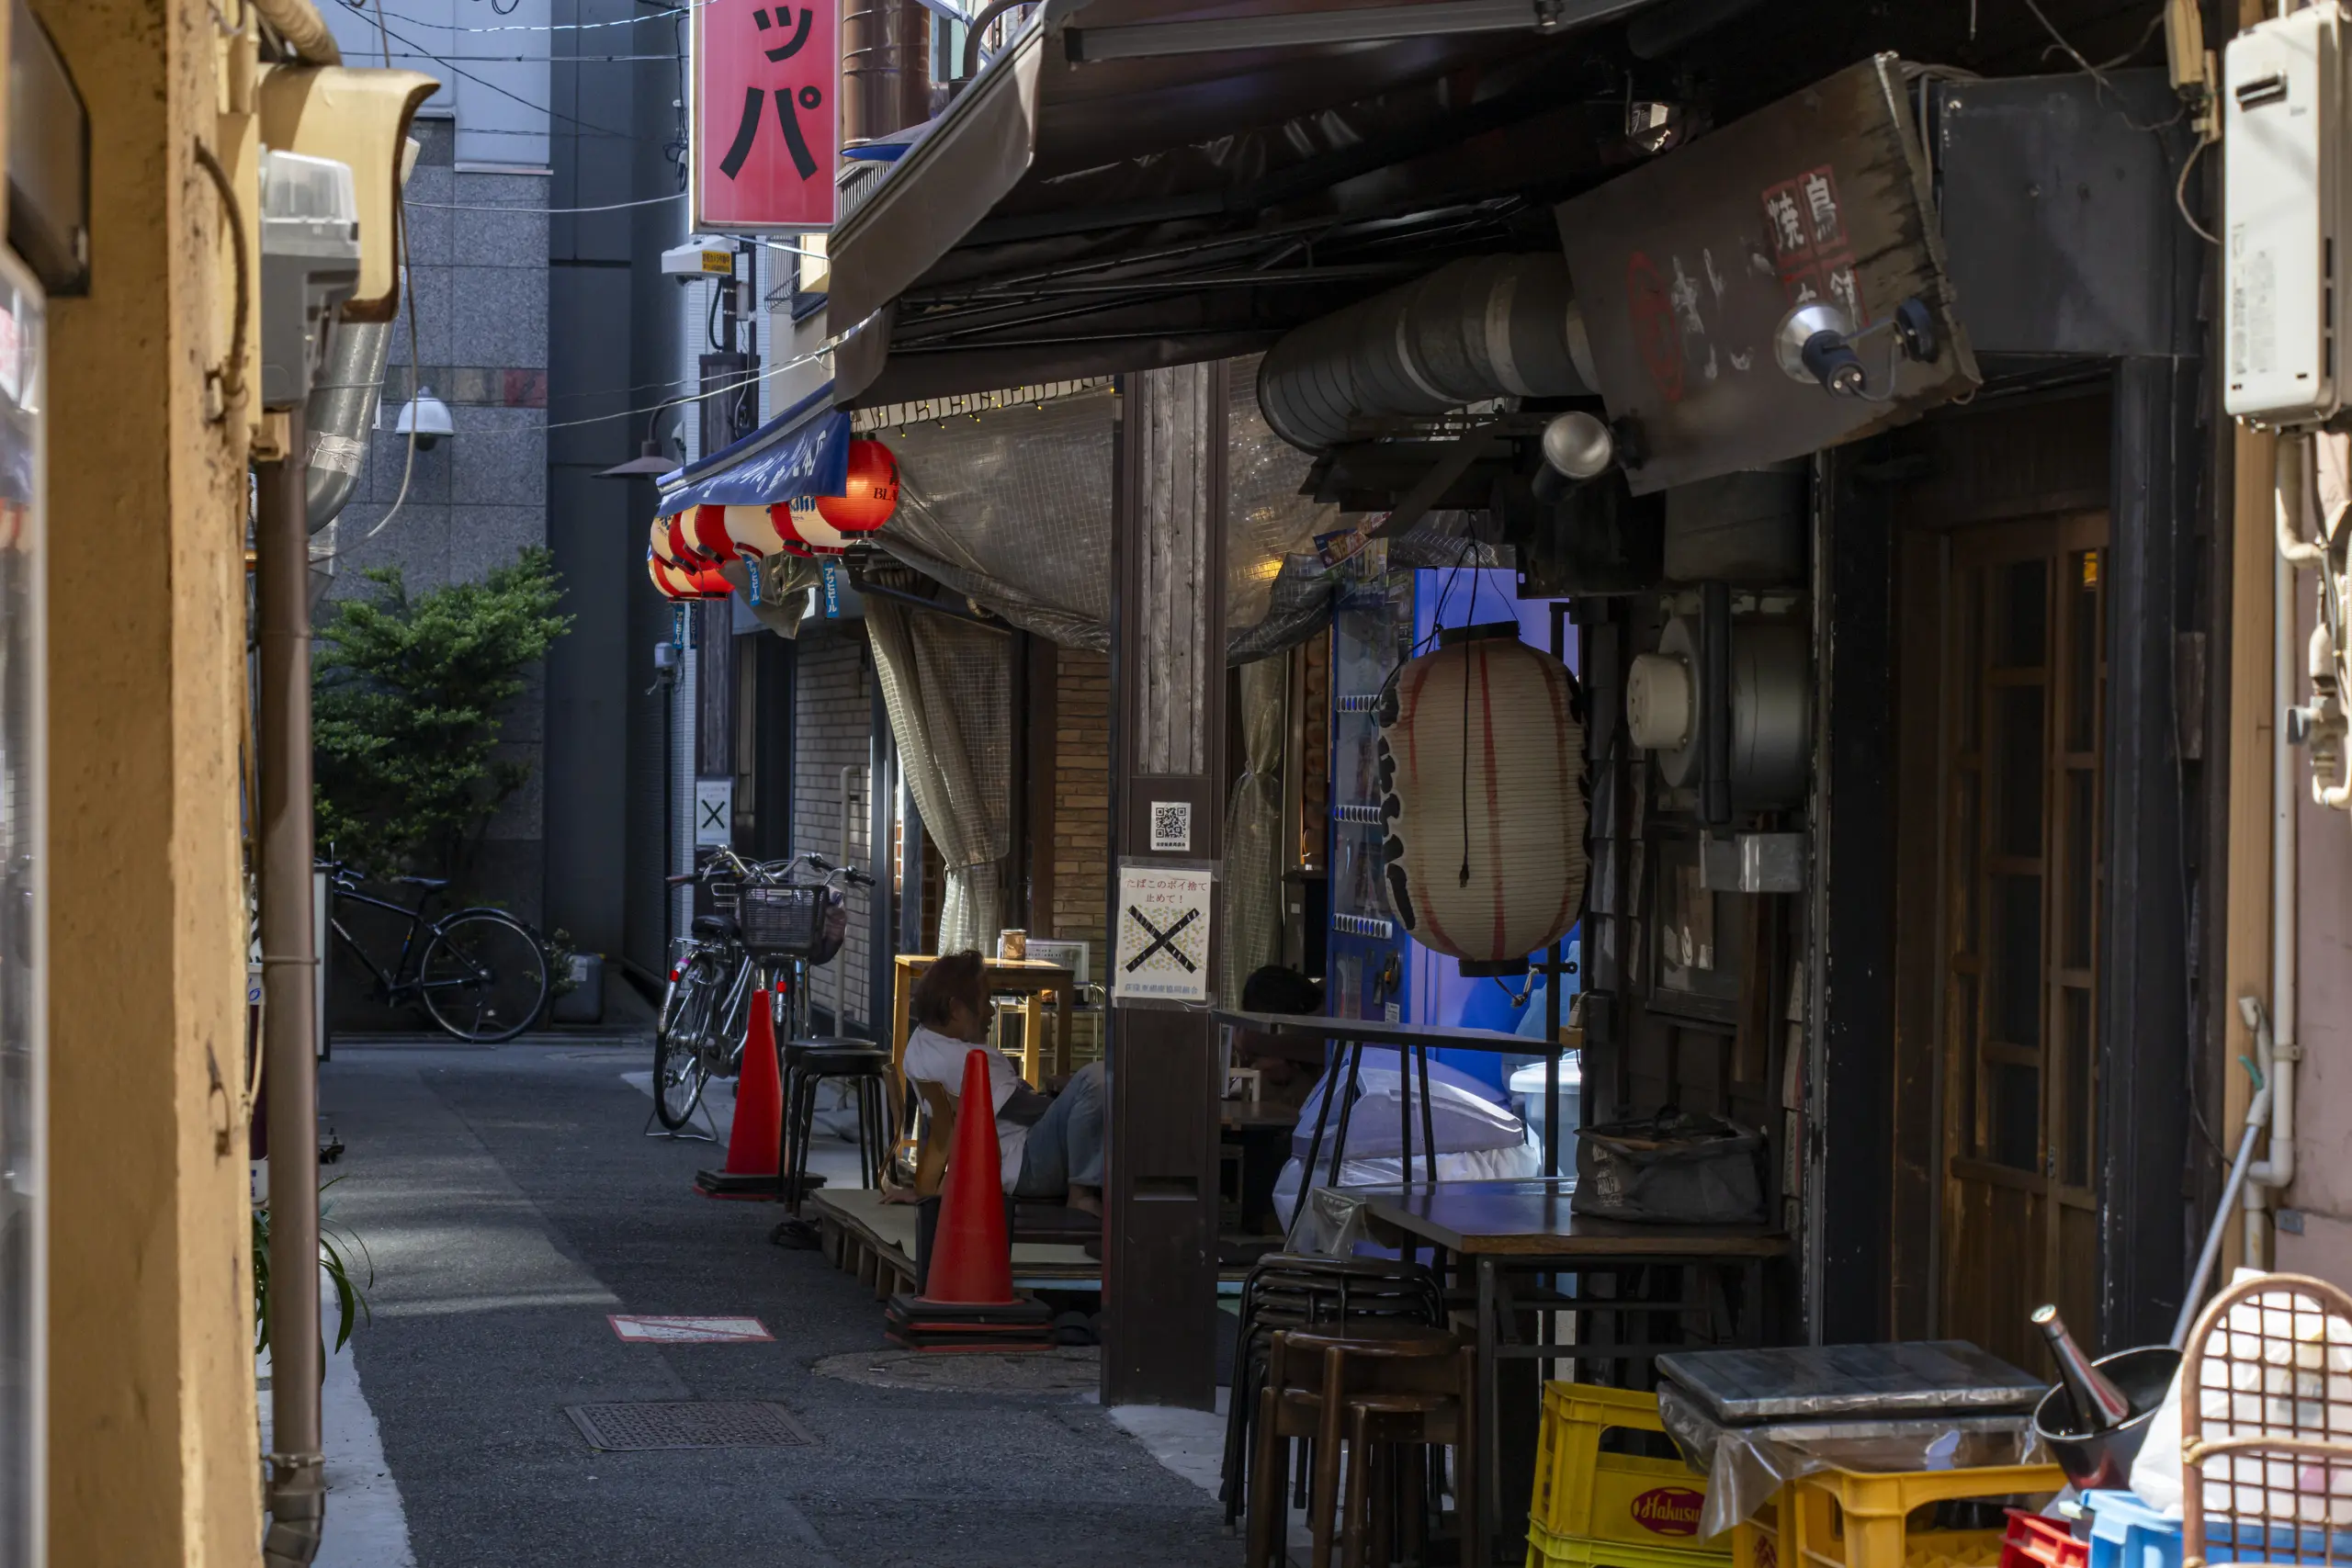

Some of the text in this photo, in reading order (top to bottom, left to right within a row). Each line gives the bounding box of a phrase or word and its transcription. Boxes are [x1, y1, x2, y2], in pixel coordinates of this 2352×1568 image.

[719, 6, 821, 181] ッパ
[874, 488, 898, 502] BLA
[746, 559, 760, 602] アサヒビール
[825, 567, 838, 613] アサヒビール
[1641, 1494, 1701, 1523] Hakusu
